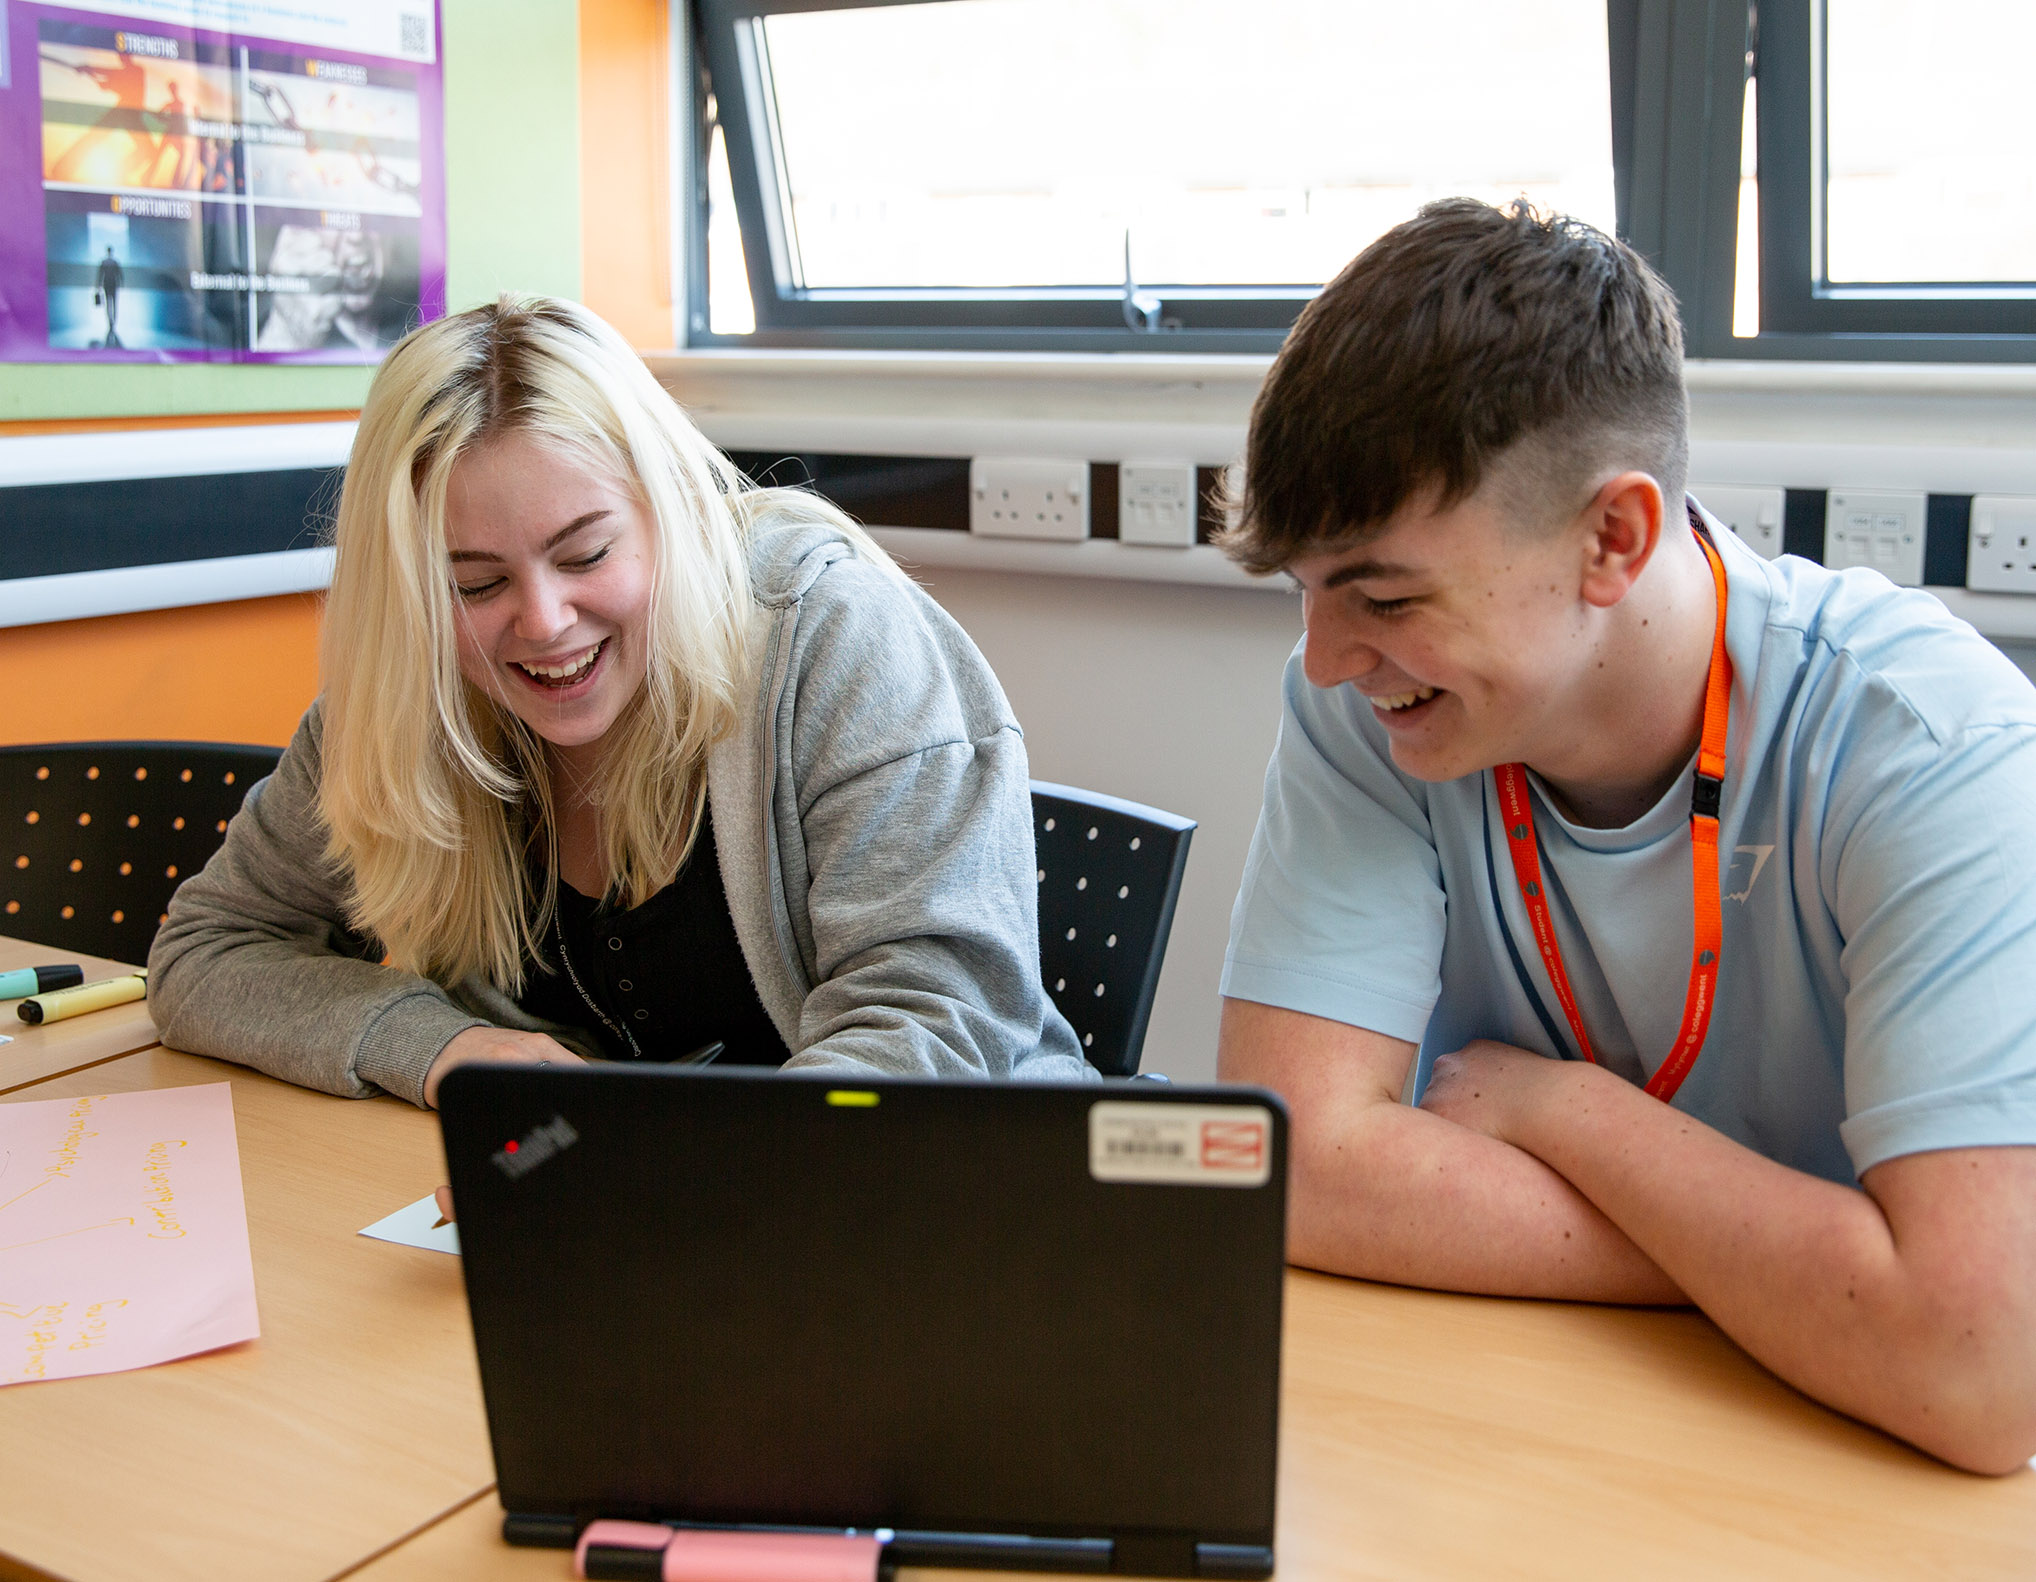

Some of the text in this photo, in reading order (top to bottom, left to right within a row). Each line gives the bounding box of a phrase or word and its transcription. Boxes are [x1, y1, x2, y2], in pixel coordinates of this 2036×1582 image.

[115, 32, 179, 59] STRENGTHS
[110, 194, 193, 219] OPPORTUNITIES
[1505, 764, 1521, 816] oleggwent
[1534, 905, 1549, 944] Student
[1691, 974, 1707, 1033] coleggwent
[68, 1299, 128, 1351] Pricing
